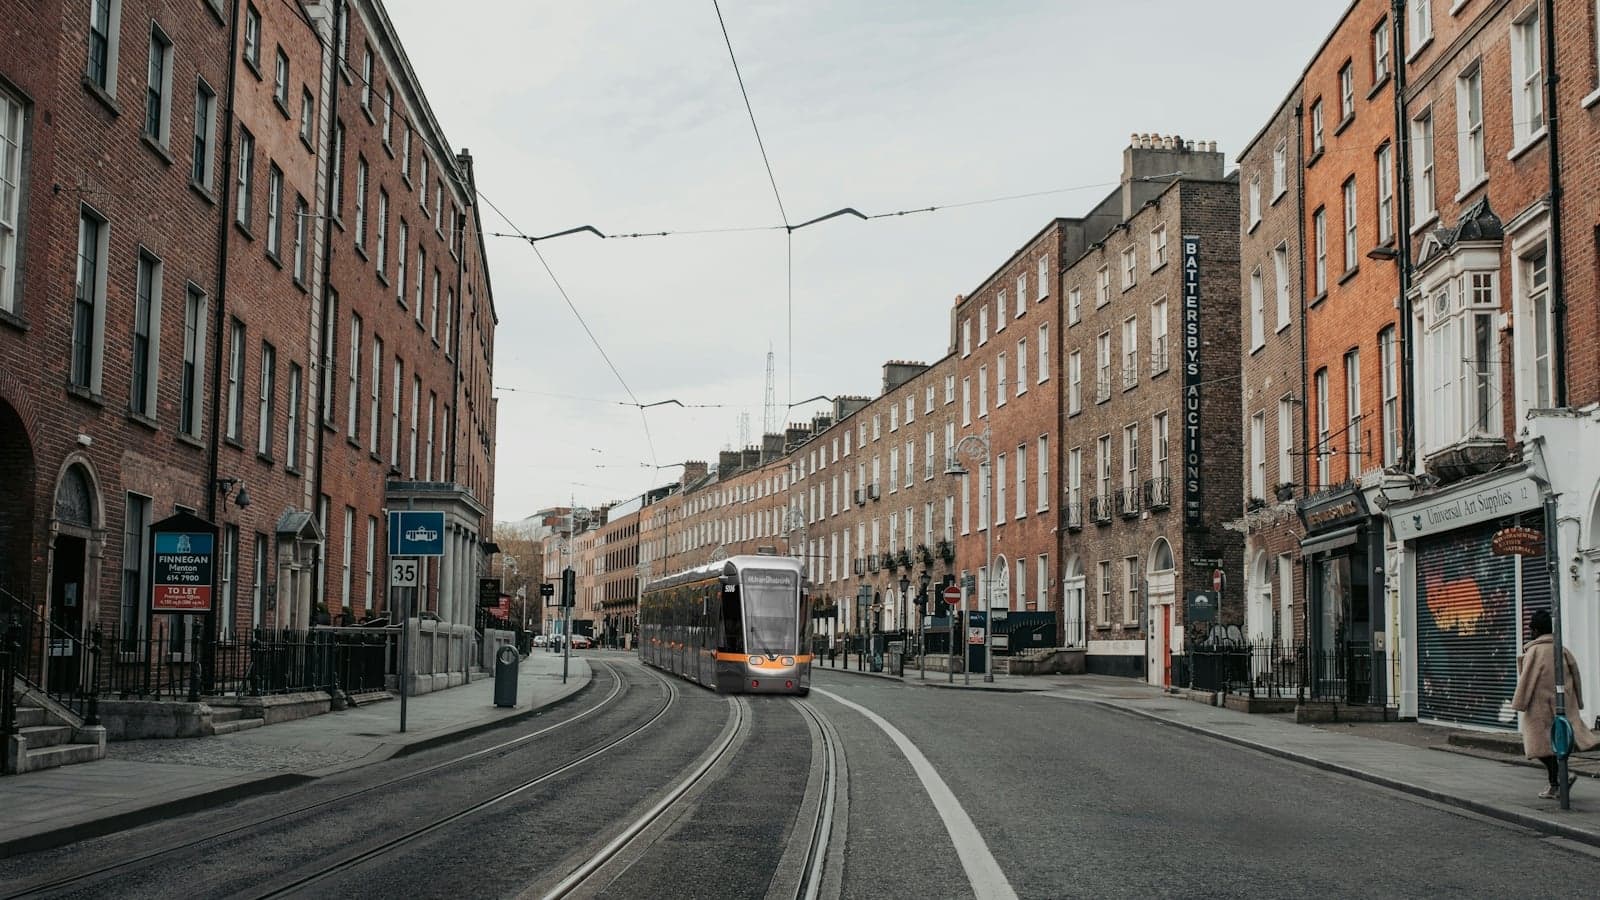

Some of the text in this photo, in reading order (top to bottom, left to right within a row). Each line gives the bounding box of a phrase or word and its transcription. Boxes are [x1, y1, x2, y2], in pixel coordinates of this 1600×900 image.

[1187, 385, 1198, 492] AUCTIONS
[1426, 501, 1461, 525] Universal
[1464, 500, 1477, 516] Art
[1480, 488, 1513, 514] Supplies
[394, 564, 415, 582] 35
